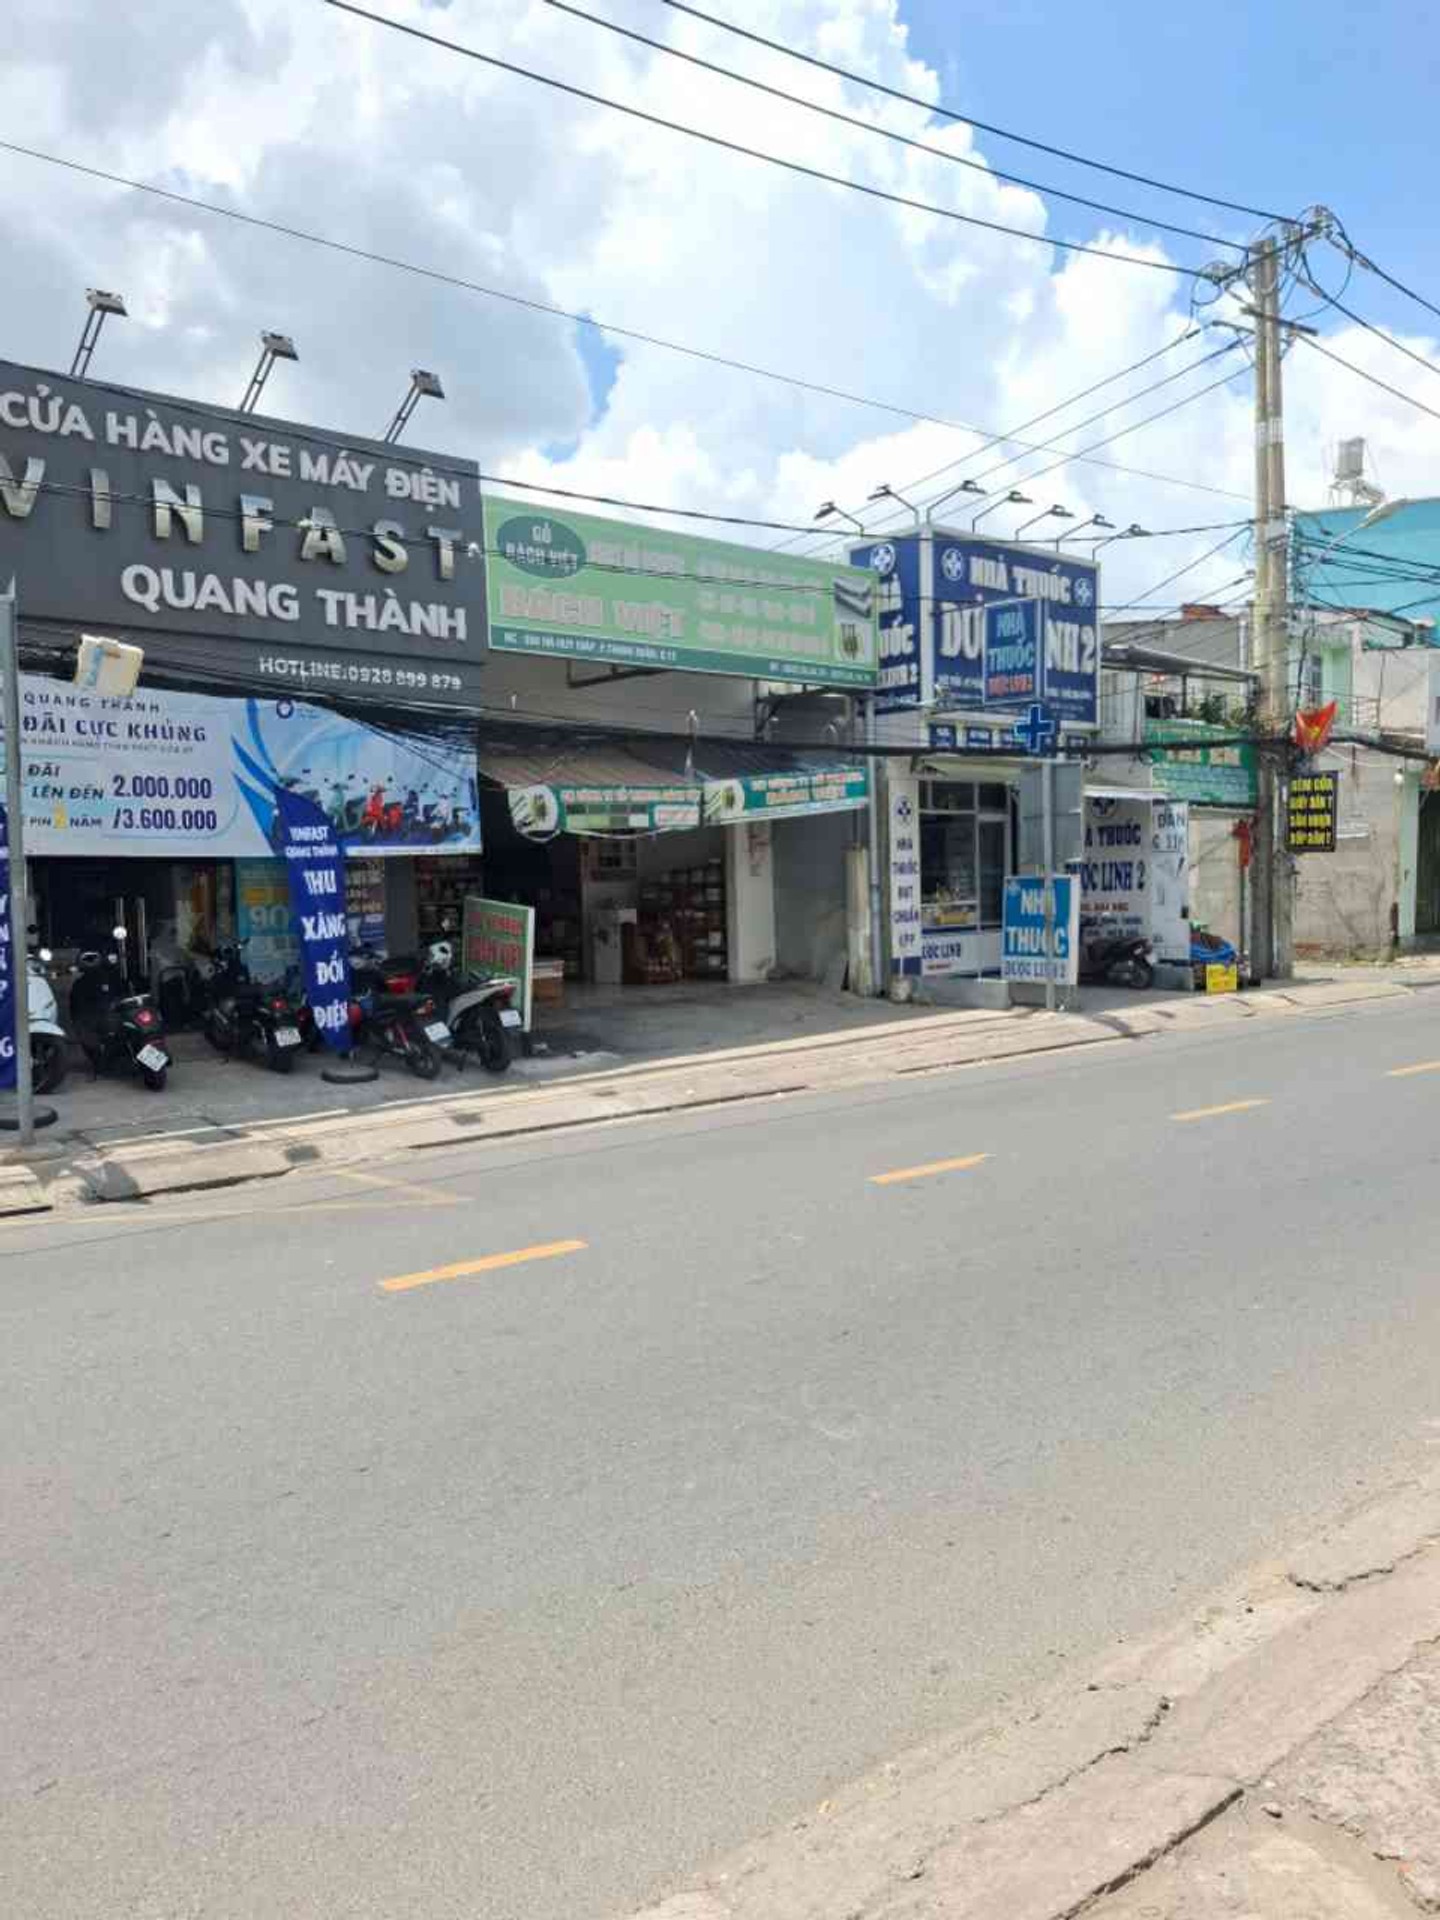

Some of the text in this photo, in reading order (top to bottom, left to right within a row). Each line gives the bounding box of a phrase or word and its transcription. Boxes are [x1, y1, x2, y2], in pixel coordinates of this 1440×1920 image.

[1, 384, 460, 510] CỬA HÀNG XE MÁY ĐIỆN
[0, 455, 462, 580] VINFAST
[1012, 564, 1072, 603] THUỐC
[121, 564, 467, 640] QUANG THÀNH
[1081, 624, 1096, 674] 2
[24, 692, 91, 708] QUANG
[23, 711, 65, 733] ĐÃI
[127, 717, 207, 742] KHỦNG
[27, 762, 61, 778] ĐÃI
[31, 774, 212, 800] LÊN ĐẾN 2.000.000
[70, 813, 102, 828] NĂM
[112, 808, 218, 830] /3.600.000
[1097, 818, 1142, 847] THUỐC
[303, 869, 337, 895] THU
[1101, 861, 1132, 892] LINH
[1138, 860, 1145, 890] 2
[301, 911, 346, 941] XĂNG
[315, 951, 344, 986] ĐỔI
[313, 1001, 348, 1030] ĐIỆN
